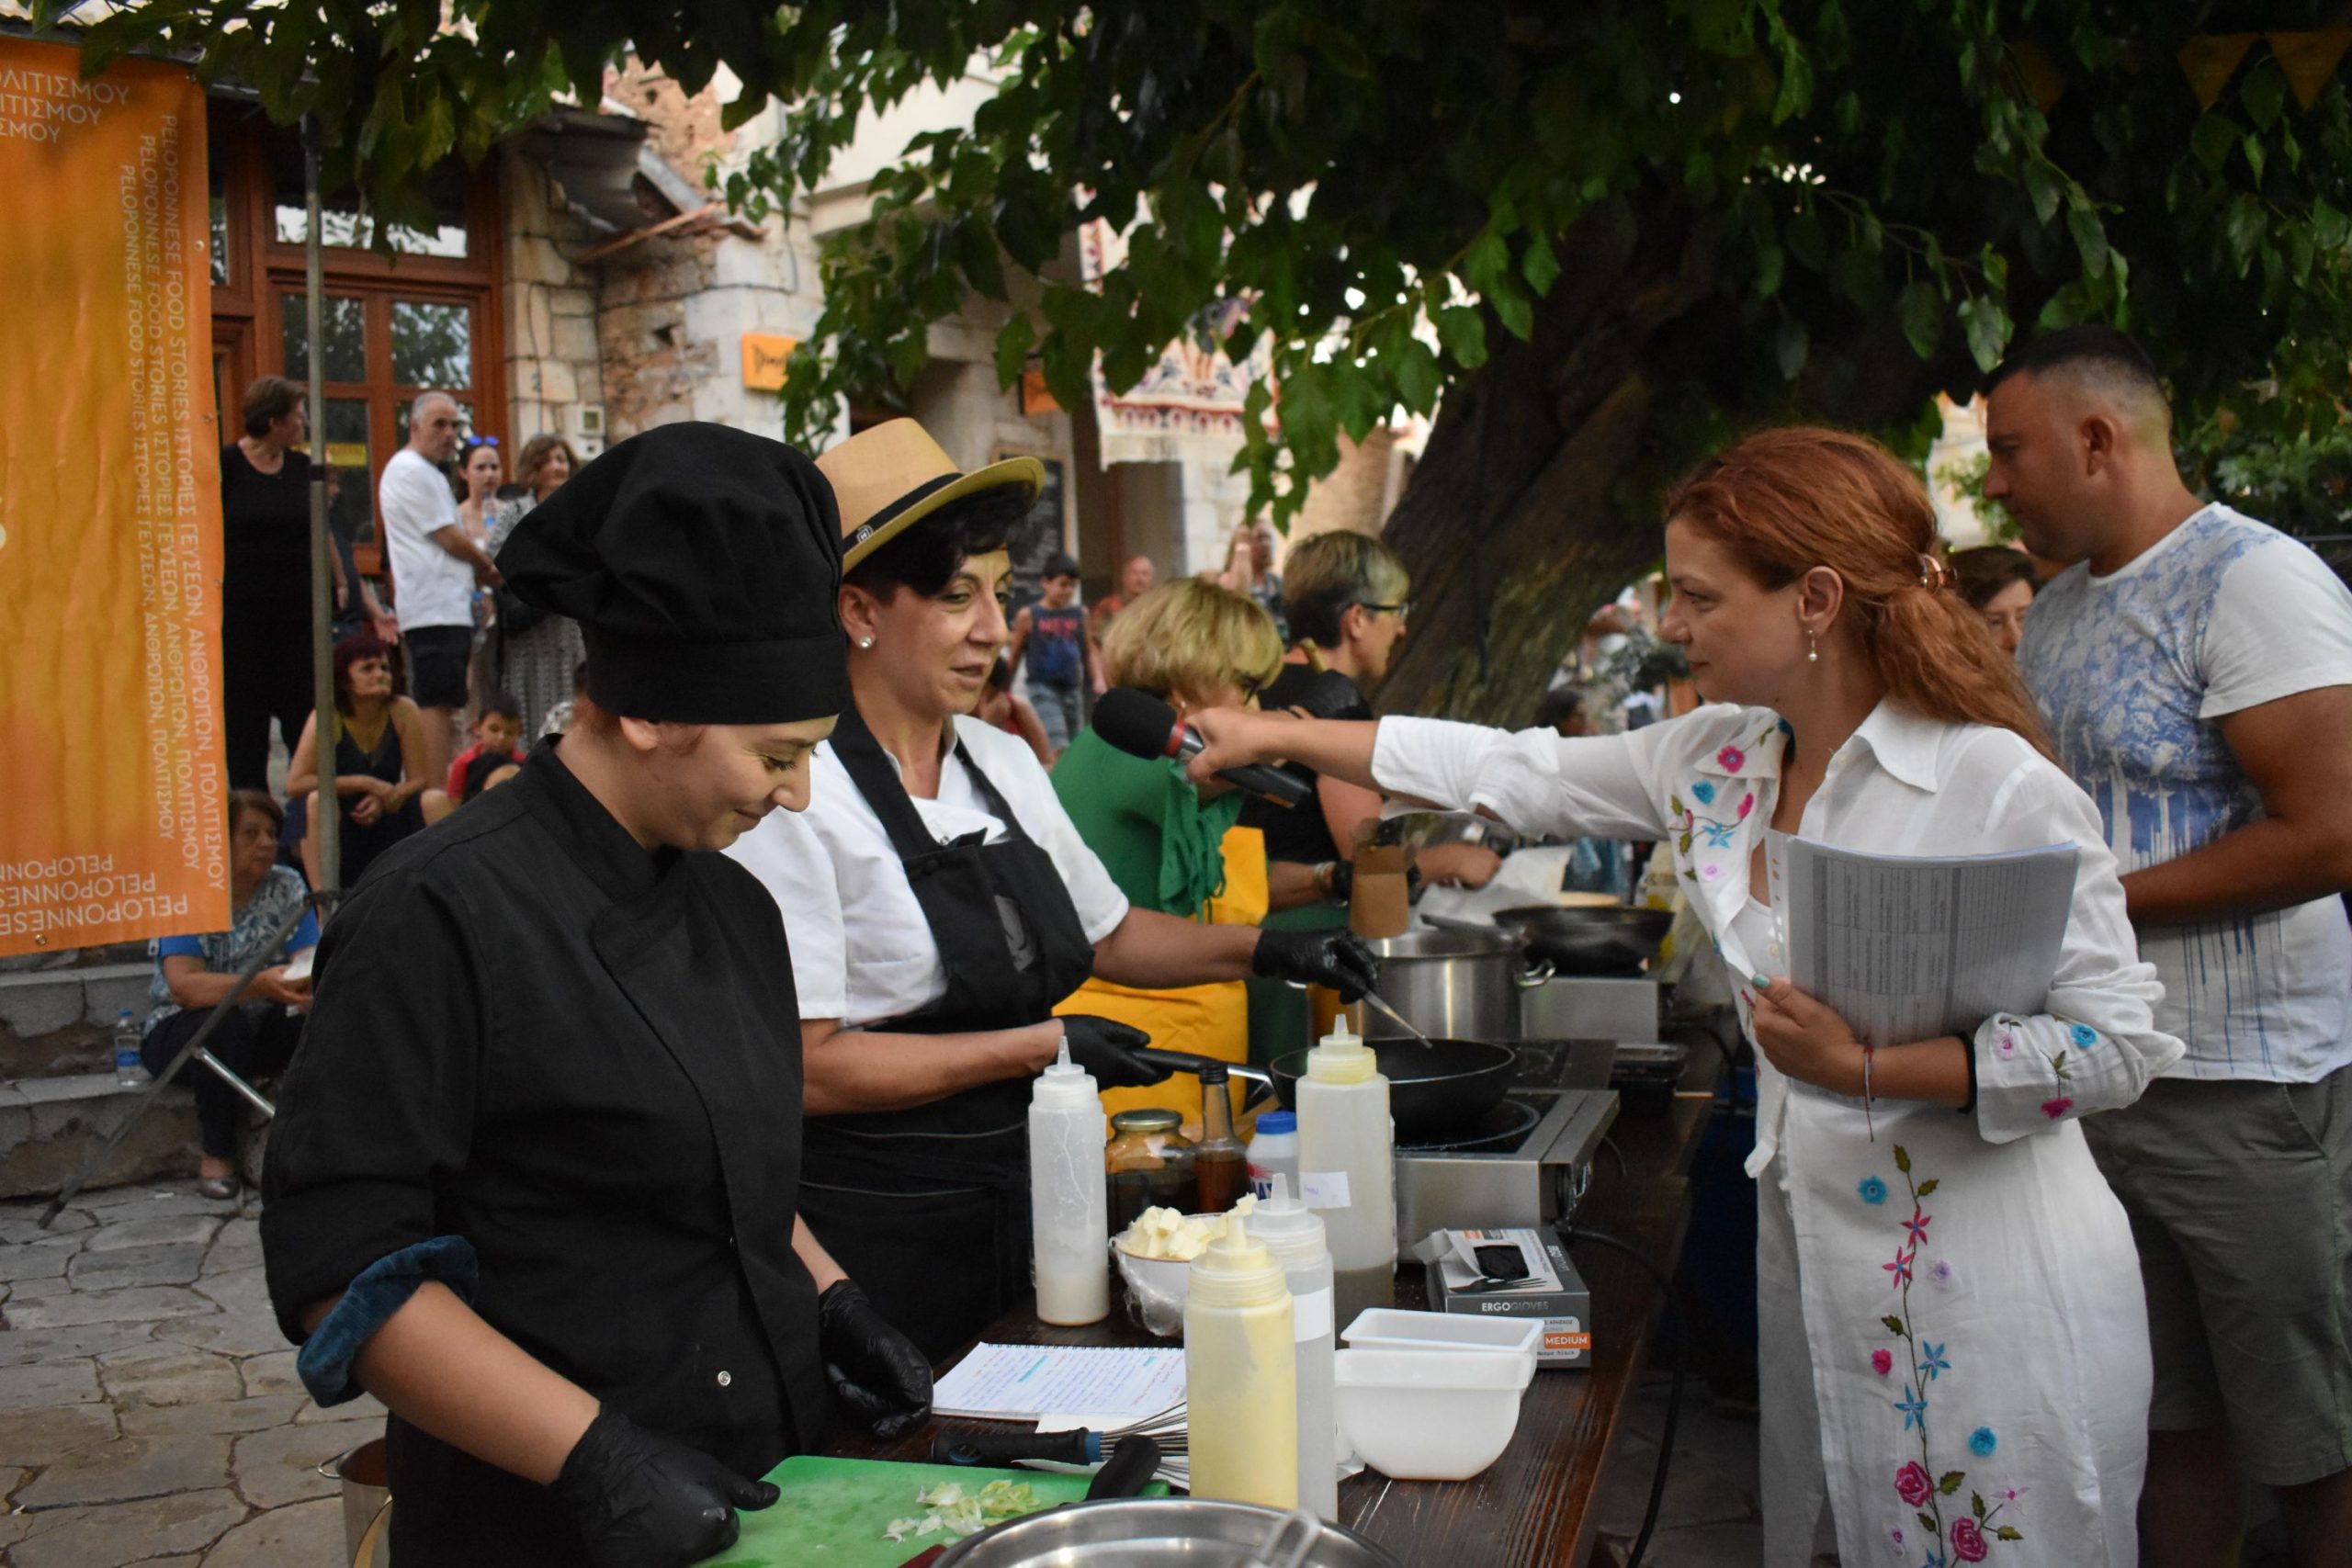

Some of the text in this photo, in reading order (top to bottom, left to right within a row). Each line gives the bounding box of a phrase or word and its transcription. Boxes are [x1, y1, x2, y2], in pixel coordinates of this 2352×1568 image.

[0, 69, 130, 105] ΛΙΤΙΣΜΟΥ
[120, 164, 175, 840] PELOPONNESE FOOD STORIES ΙΣΤΟΡΙΕΣ ΓΕΥΣΕΩΝ, ΑΝΘΡΩΠΩΝ, ΠΟΛΙΤΙΣΜΟΥ
[140, 135, 199, 869] PELOPONNESE FOOD STORIES ΙΣΤΟΡΙΕΣ ΓΕΥΣΕΩΝ, ΑΝΘΡΩΠΩΝ, ΠΟΛΙΤΙΣΜΟΥ
[162, 115, 225, 890] PELOPONNESE FOOD STORIES ΙΣΤΟΡΙΕΣ ΓΕΥΣΕΩΝ, ΑΝΘΡΩΠΩΝ, ΠΟΛΙΤΙΣΜΟΥ
[0, 853, 113, 883] PELOPON
[0, 894, 187, 936] PELOPONNESE
[1481, 1301, 1549, 1312] ERGOGLOVES
[1545, 1336, 1588, 1346] MEDIUM
